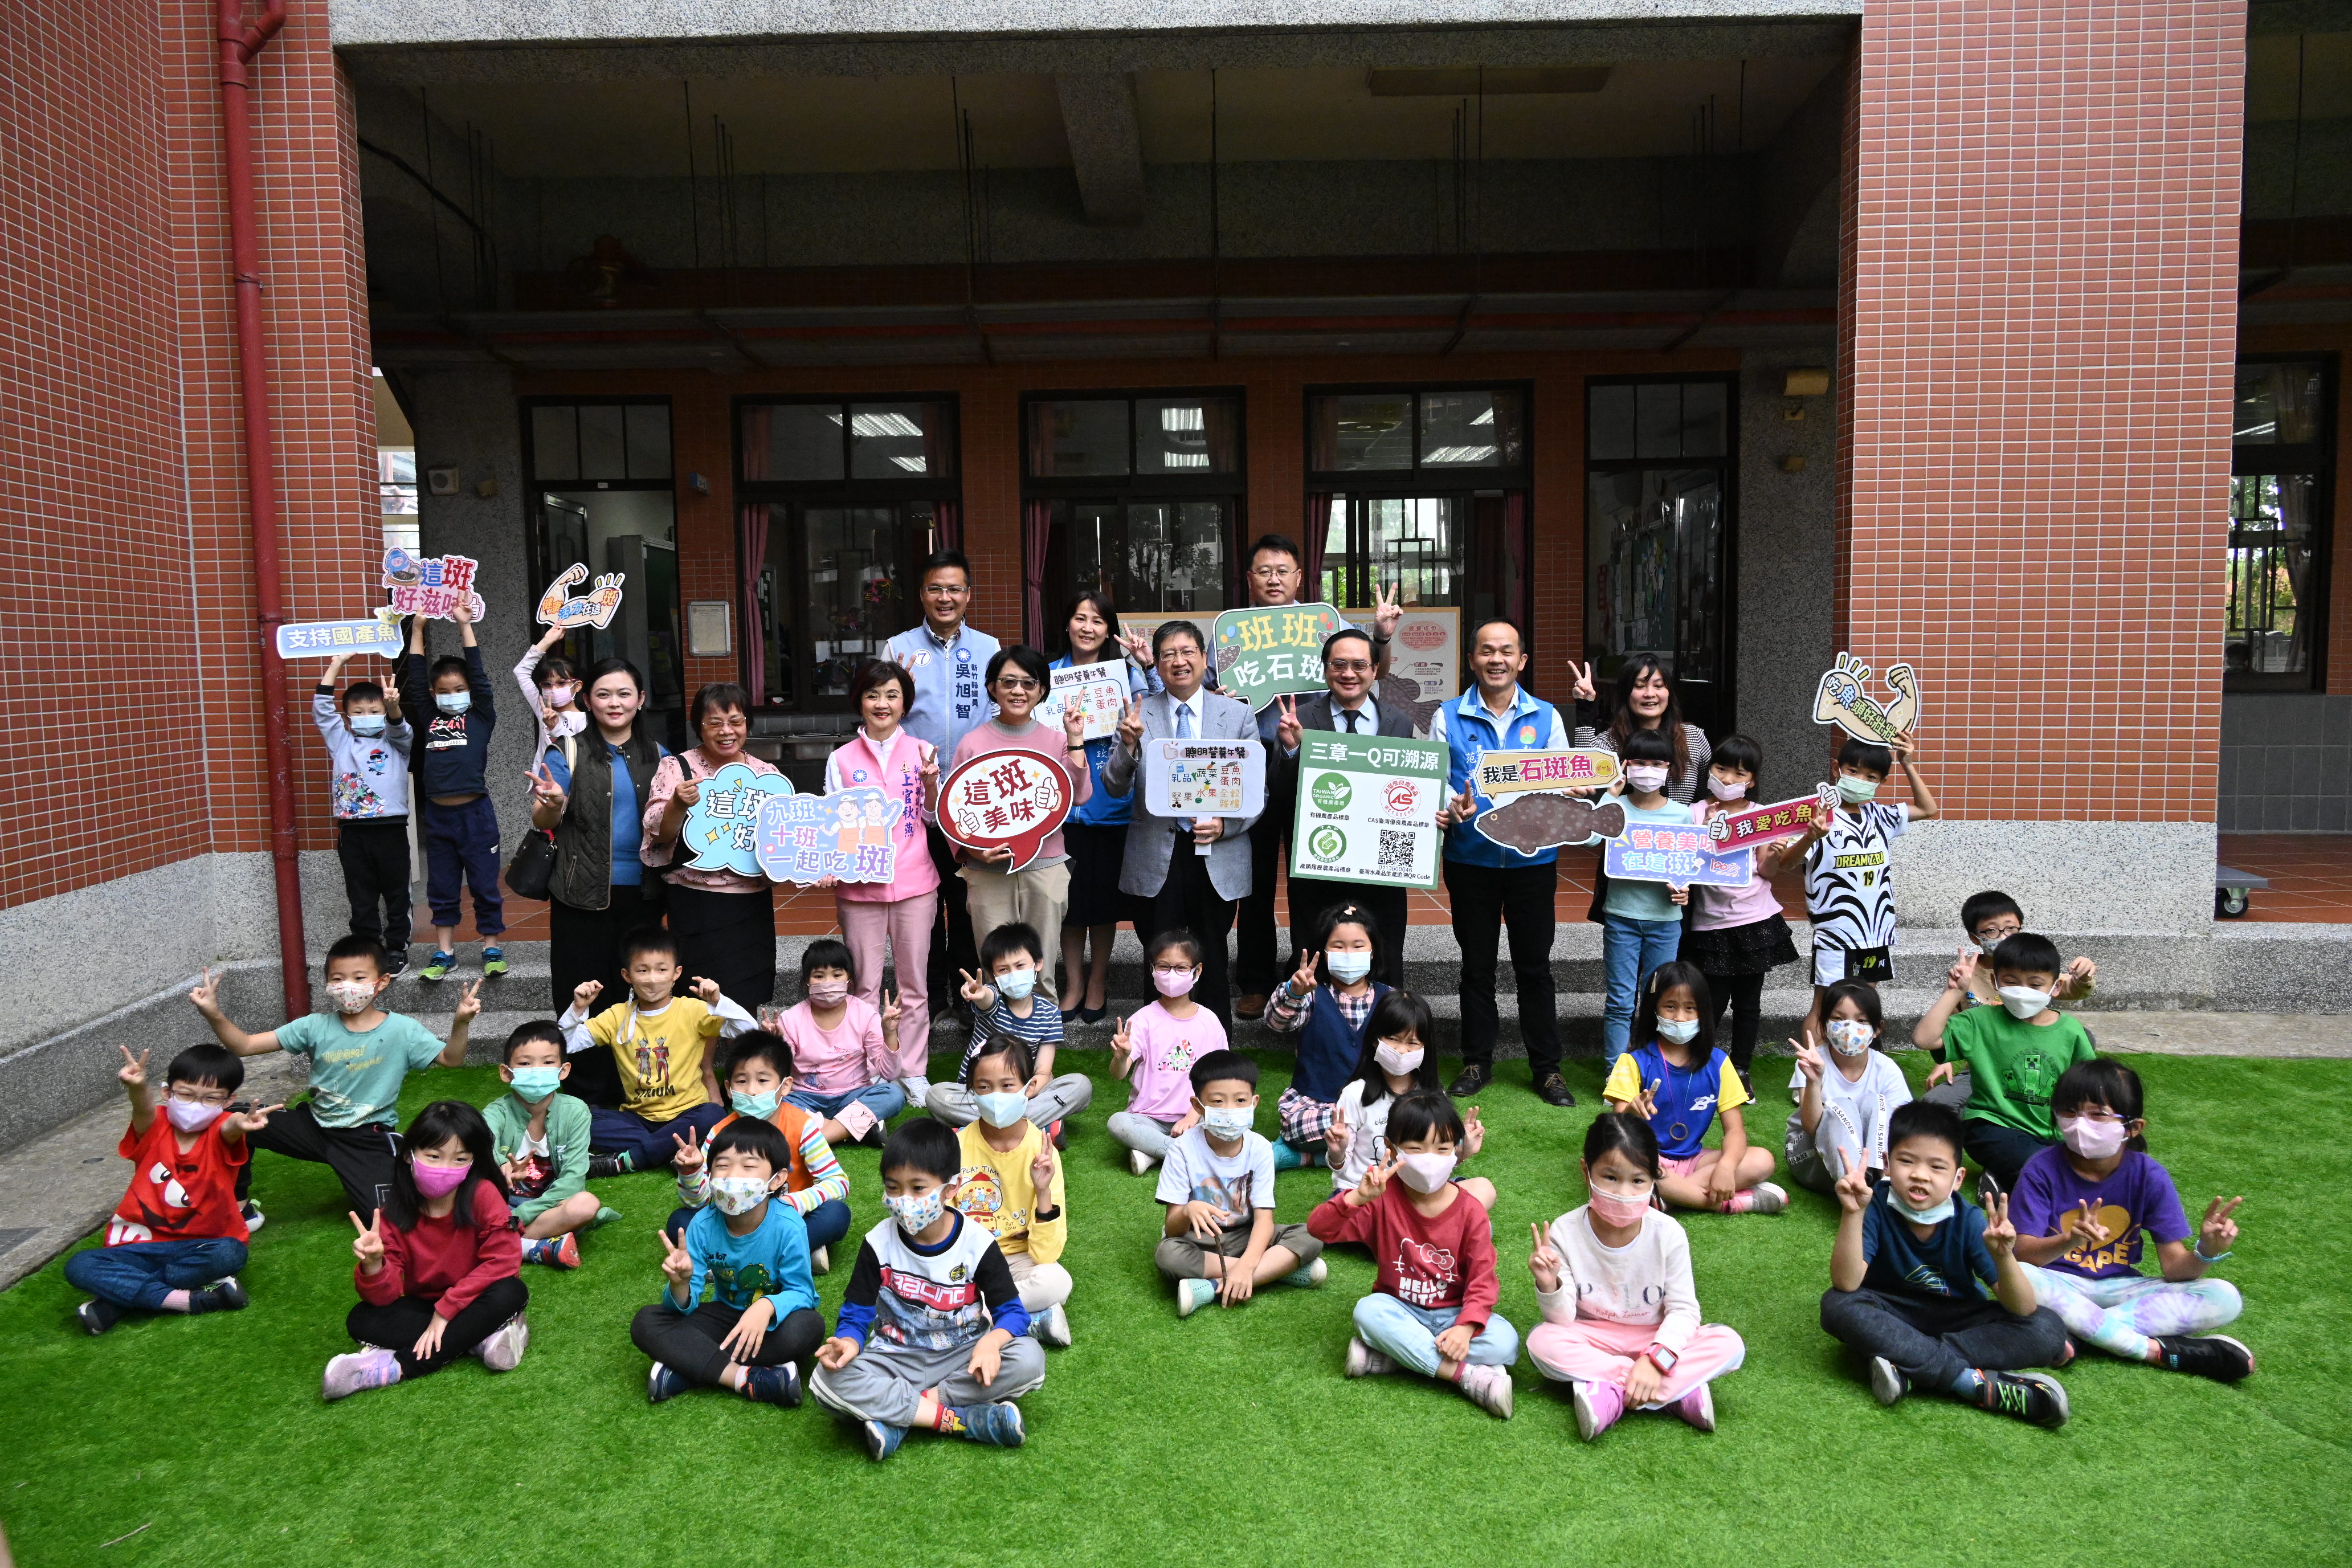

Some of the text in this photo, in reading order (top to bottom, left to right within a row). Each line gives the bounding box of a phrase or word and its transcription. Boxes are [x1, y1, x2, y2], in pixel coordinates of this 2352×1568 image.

[420, 558, 474, 591] 這斑
[542, 589, 619, 620] 健康活力在這斑
[287, 623, 398, 649] 支持國產魚
[1237, 612, 1318, 651] 班班
[917, 652, 927, 665] 7
[1053, 667, 1107, 685] 聰明營養午餐
[1233, 653, 1326, 687] 吃石斑
[956, 663, 971, 719] 吳旭智
[1094, 686, 1116, 699] 豆魚
[1096, 698, 1118, 710] 蛋肉
[1185, 746, 1246, 760] 聰明營養午餐
[1310, 742, 1440, 771] 三章一Q可溯源
[900, 760, 910, 773] 4
[1197, 768, 1218, 778] 蔬菜
[1220, 765, 1241, 775] 豆魚
[1483, 754, 1595, 784] 我是石斑魚
[963, 758, 1033, 806] 這斑
[1171, 773, 1192, 783] 乳品
[1220, 776, 1241, 786] 蛋肉
[1172, 792, 1193, 802] 堅果
[1196, 789, 1217, 798] 水果
[982, 798, 1036, 834] 美味
[1310, 812, 1350, 820] 有機農產品標章
[1736, 804, 1813, 838] 我愛吃魚
[767, 844, 891, 877] 一起吃斑
[1622, 851, 1698, 876] 在這斑
[1863, 871, 1874, 886] 19
[961, 1166, 979, 1174] PLAY
[1399, 1276, 1448, 1293] HELLO
[1399, 1289, 1447, 1305] KITTY
[1577, 1283, 1664, 1309] POLO
[1595, 1308, 1619, 1319] Ralph
